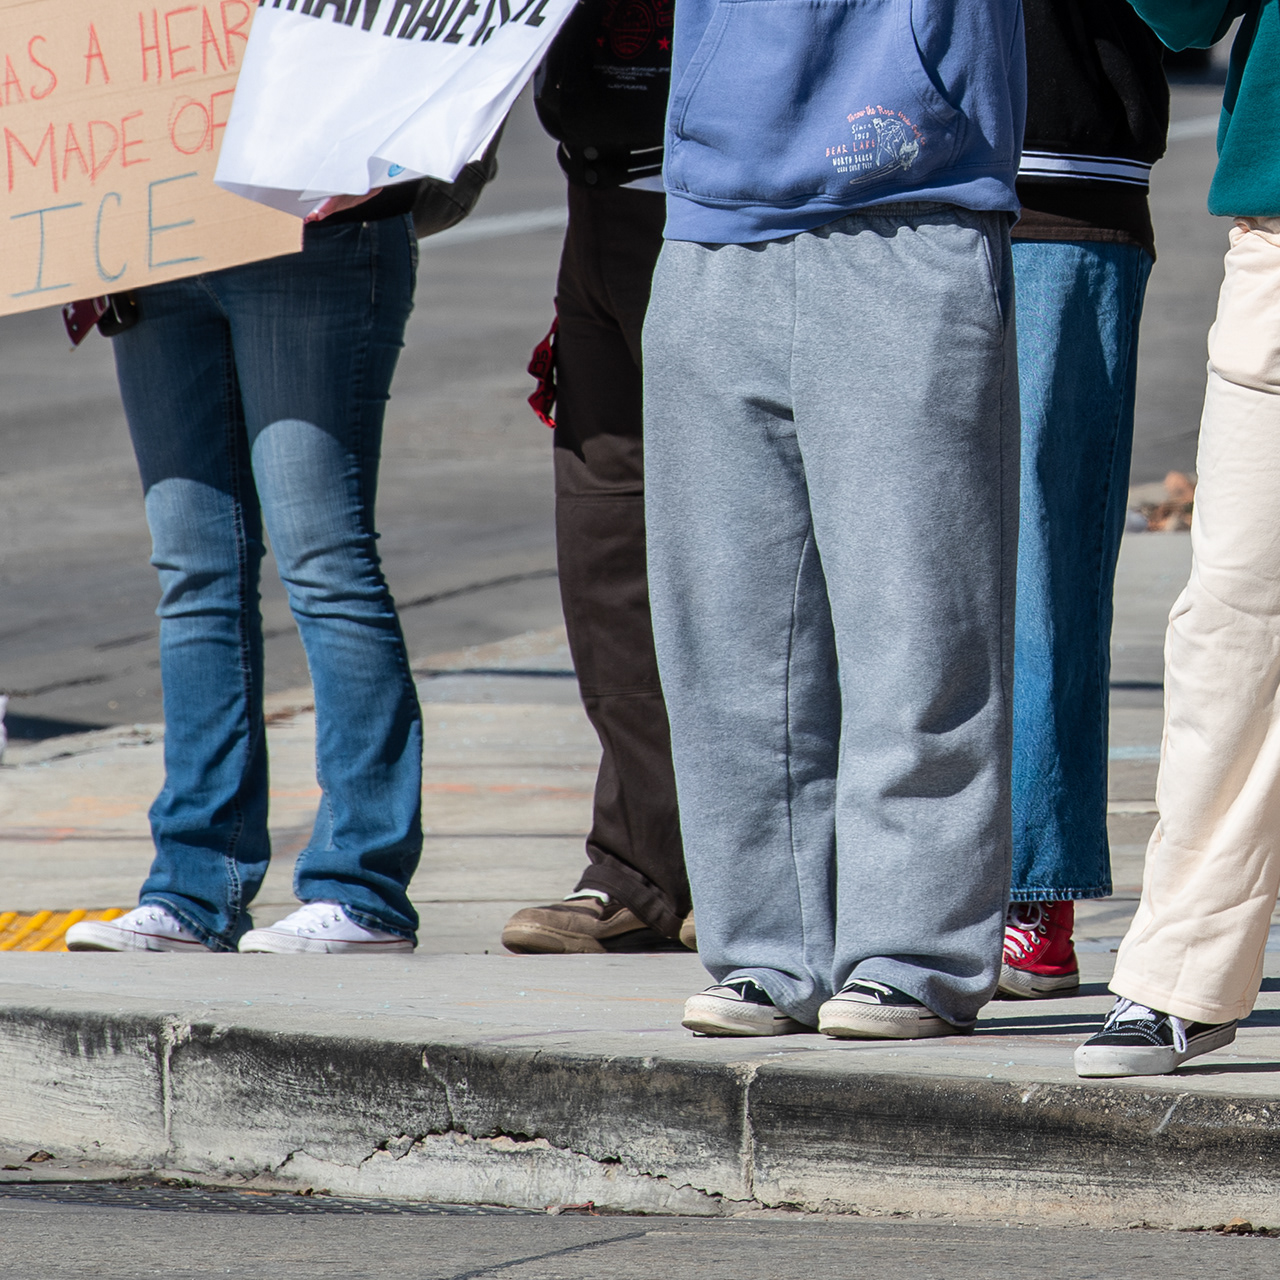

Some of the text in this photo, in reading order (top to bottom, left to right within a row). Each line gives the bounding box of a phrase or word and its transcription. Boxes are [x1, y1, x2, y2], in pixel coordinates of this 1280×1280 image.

[0, 35, 57, 106] AS
[84, 23, 110, 85] A
[4, 90, 236, 193] MADE OF
[10, 172, 205, 298] ICE
